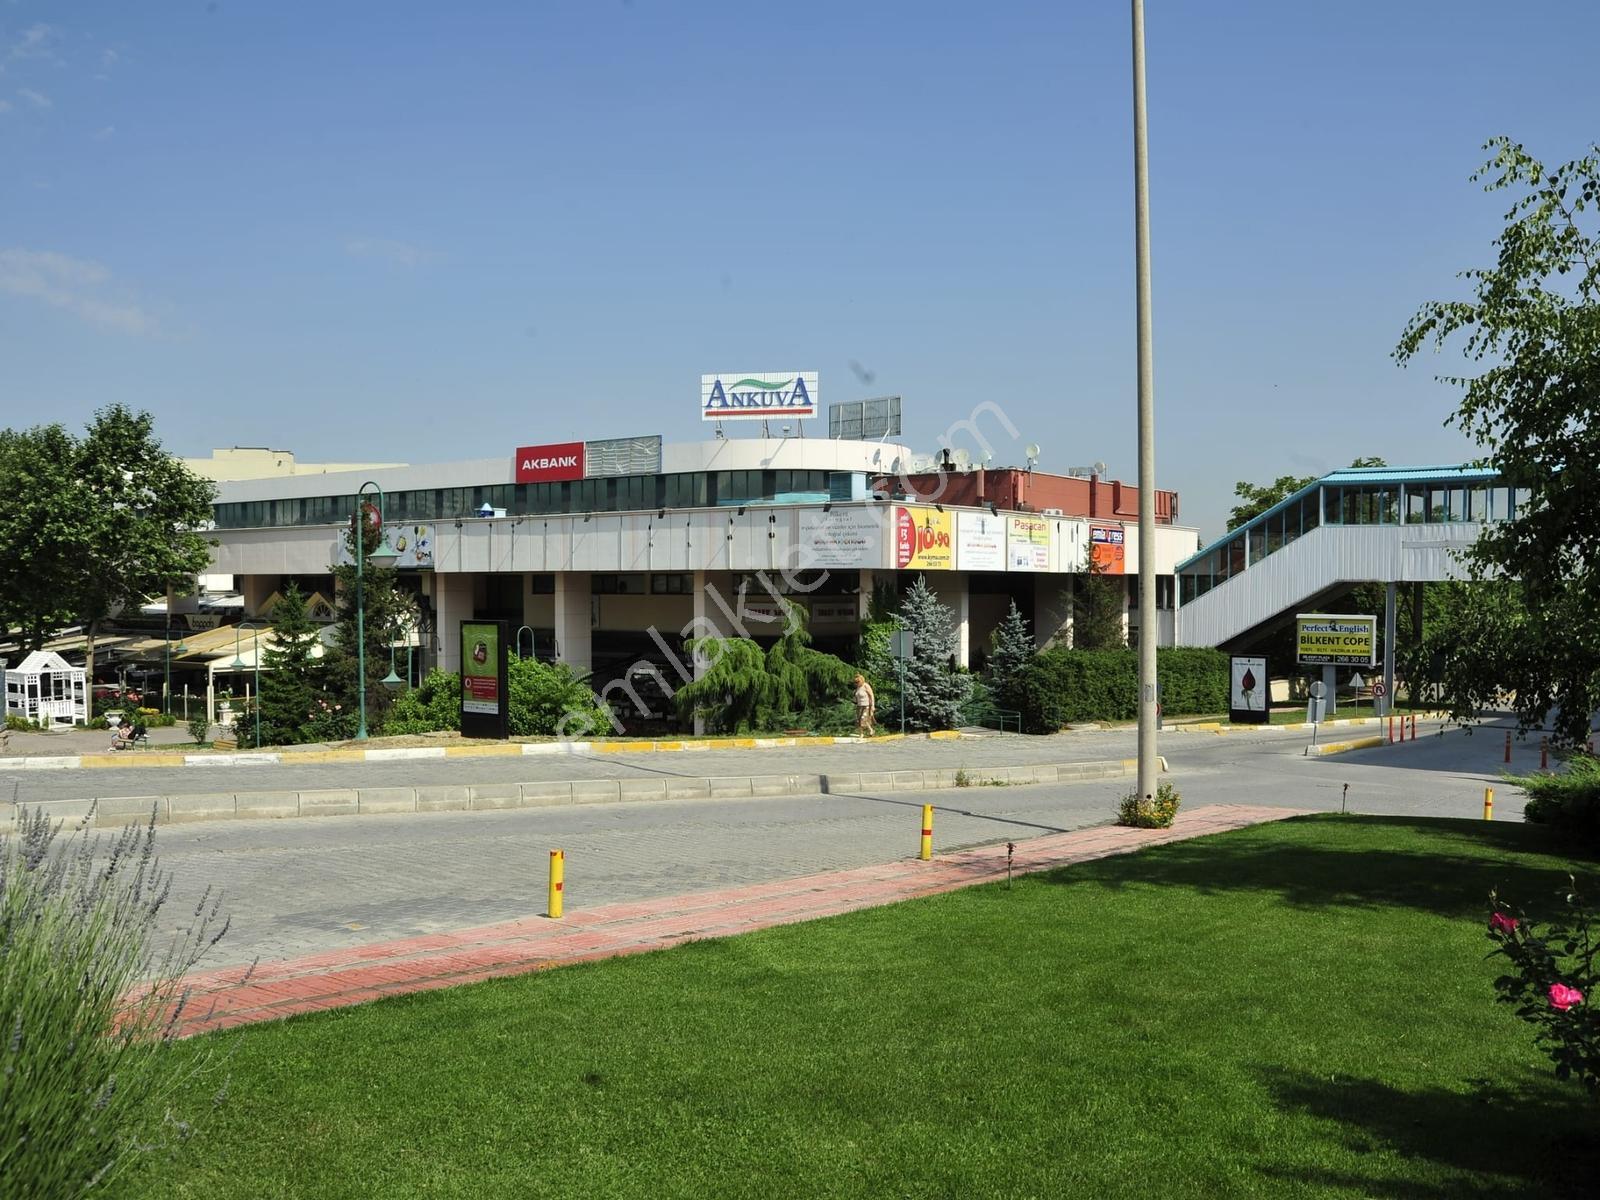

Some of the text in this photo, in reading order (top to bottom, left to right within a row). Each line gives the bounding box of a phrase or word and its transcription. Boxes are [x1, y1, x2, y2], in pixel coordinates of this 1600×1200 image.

[522, 456, 577, 470] AKBANK
[1302, 624, 1369, 634] Perfect English
[1300, 635, 1370, 646] BİLKENT COPE
